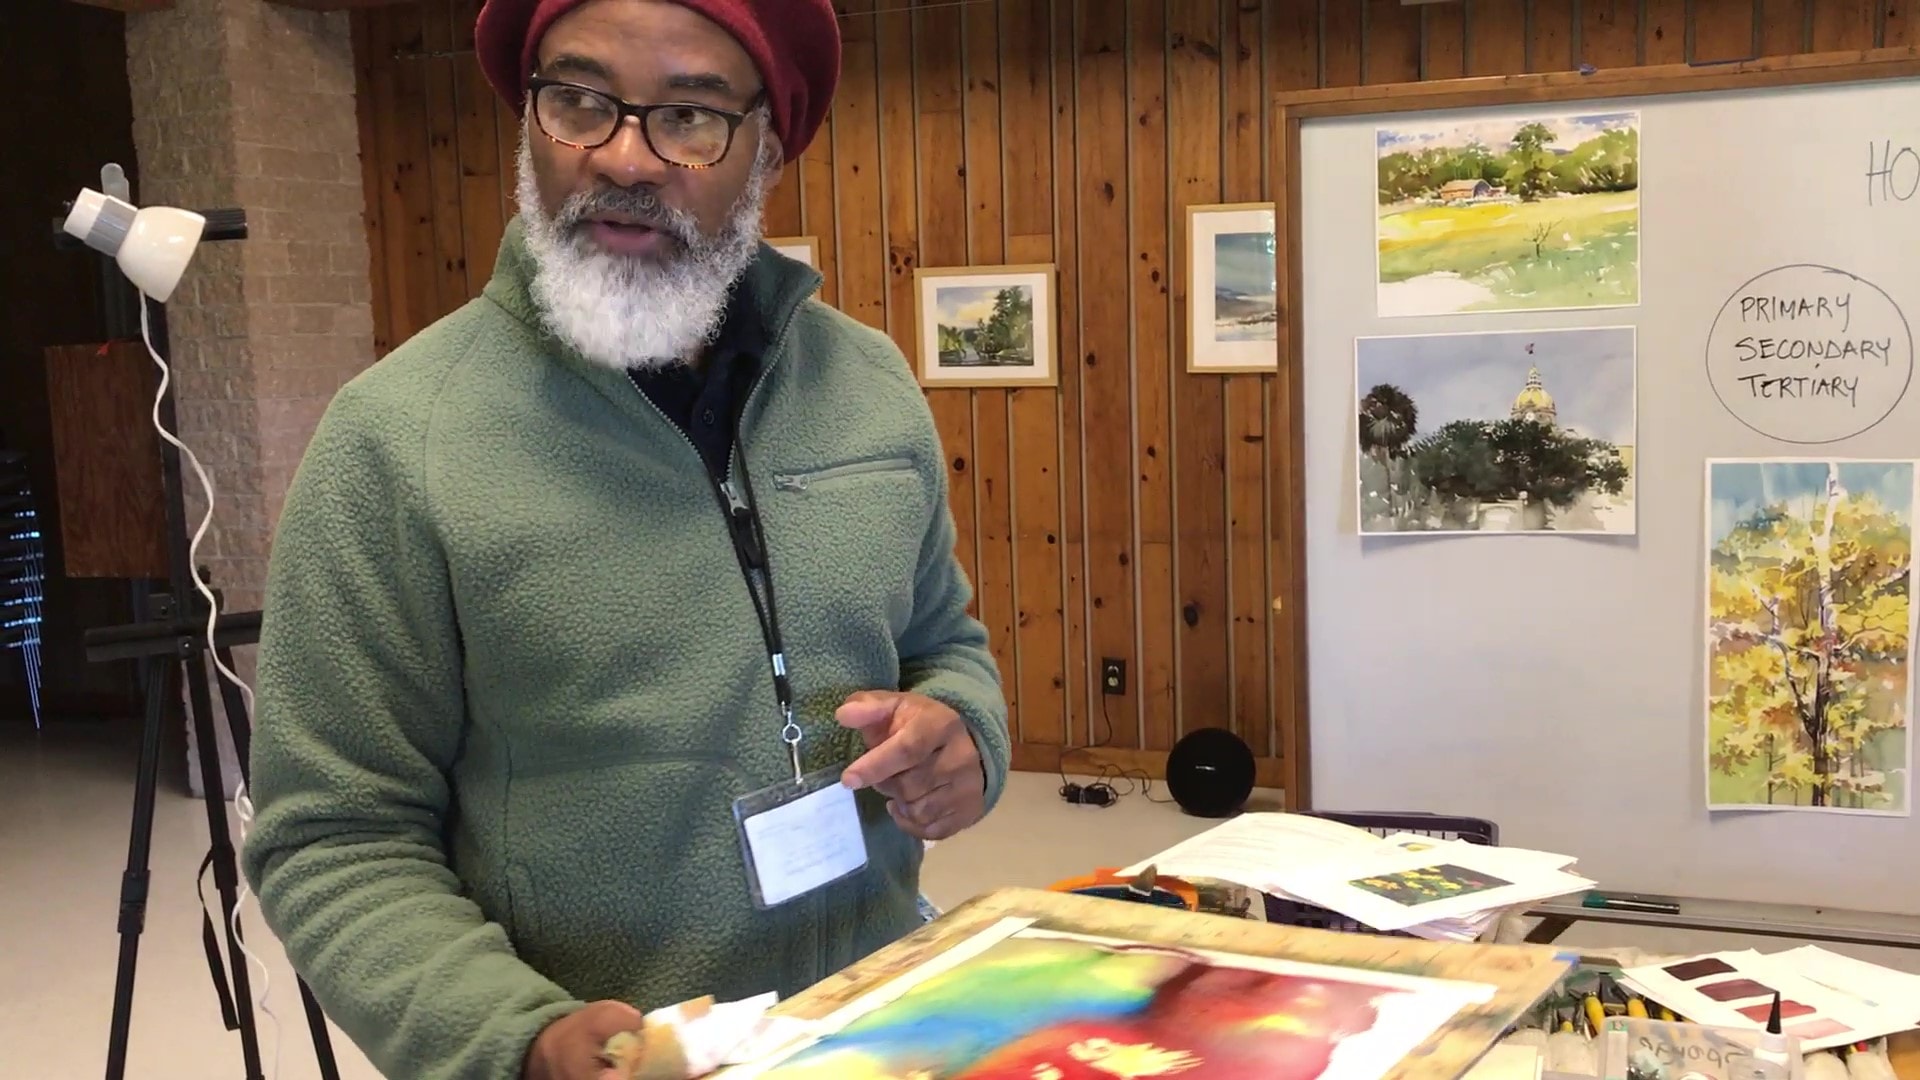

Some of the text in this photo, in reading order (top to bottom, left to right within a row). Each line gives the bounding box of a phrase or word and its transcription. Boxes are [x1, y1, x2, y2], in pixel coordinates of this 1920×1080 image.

[1740, 293, 1850, 333] PRIMARY
[1735, 337, 1891, 367] SECONDARY
[1737, 372, 1859, 408] TERTIARY
